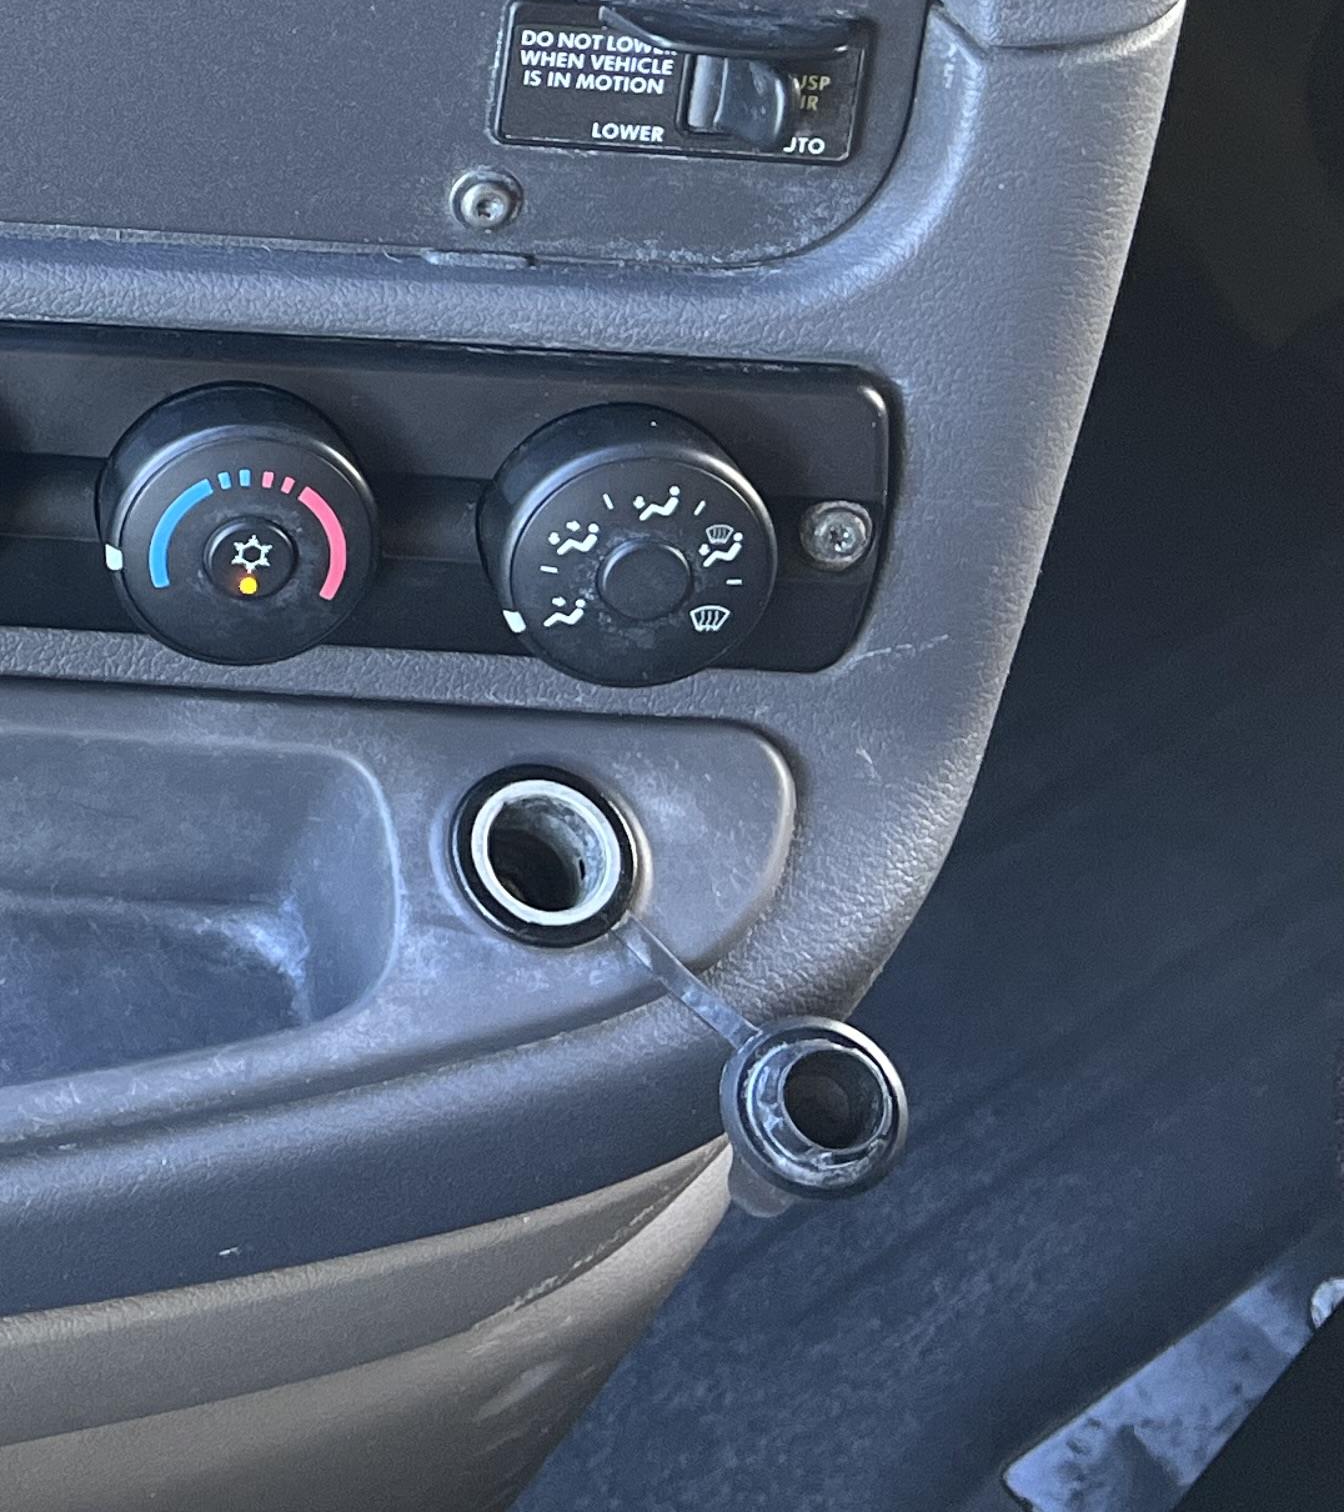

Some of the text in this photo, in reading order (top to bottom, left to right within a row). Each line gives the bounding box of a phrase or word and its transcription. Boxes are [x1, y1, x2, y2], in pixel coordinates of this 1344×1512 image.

[521, 30, 554, 47] DO
[558, 32, 604, 50] NOT
[520, 50, 674, 75] WHEN VEHICLE
[523, 70, 665, 94] IS IN MOTION
[592, 122, 665, 141] LOWER
